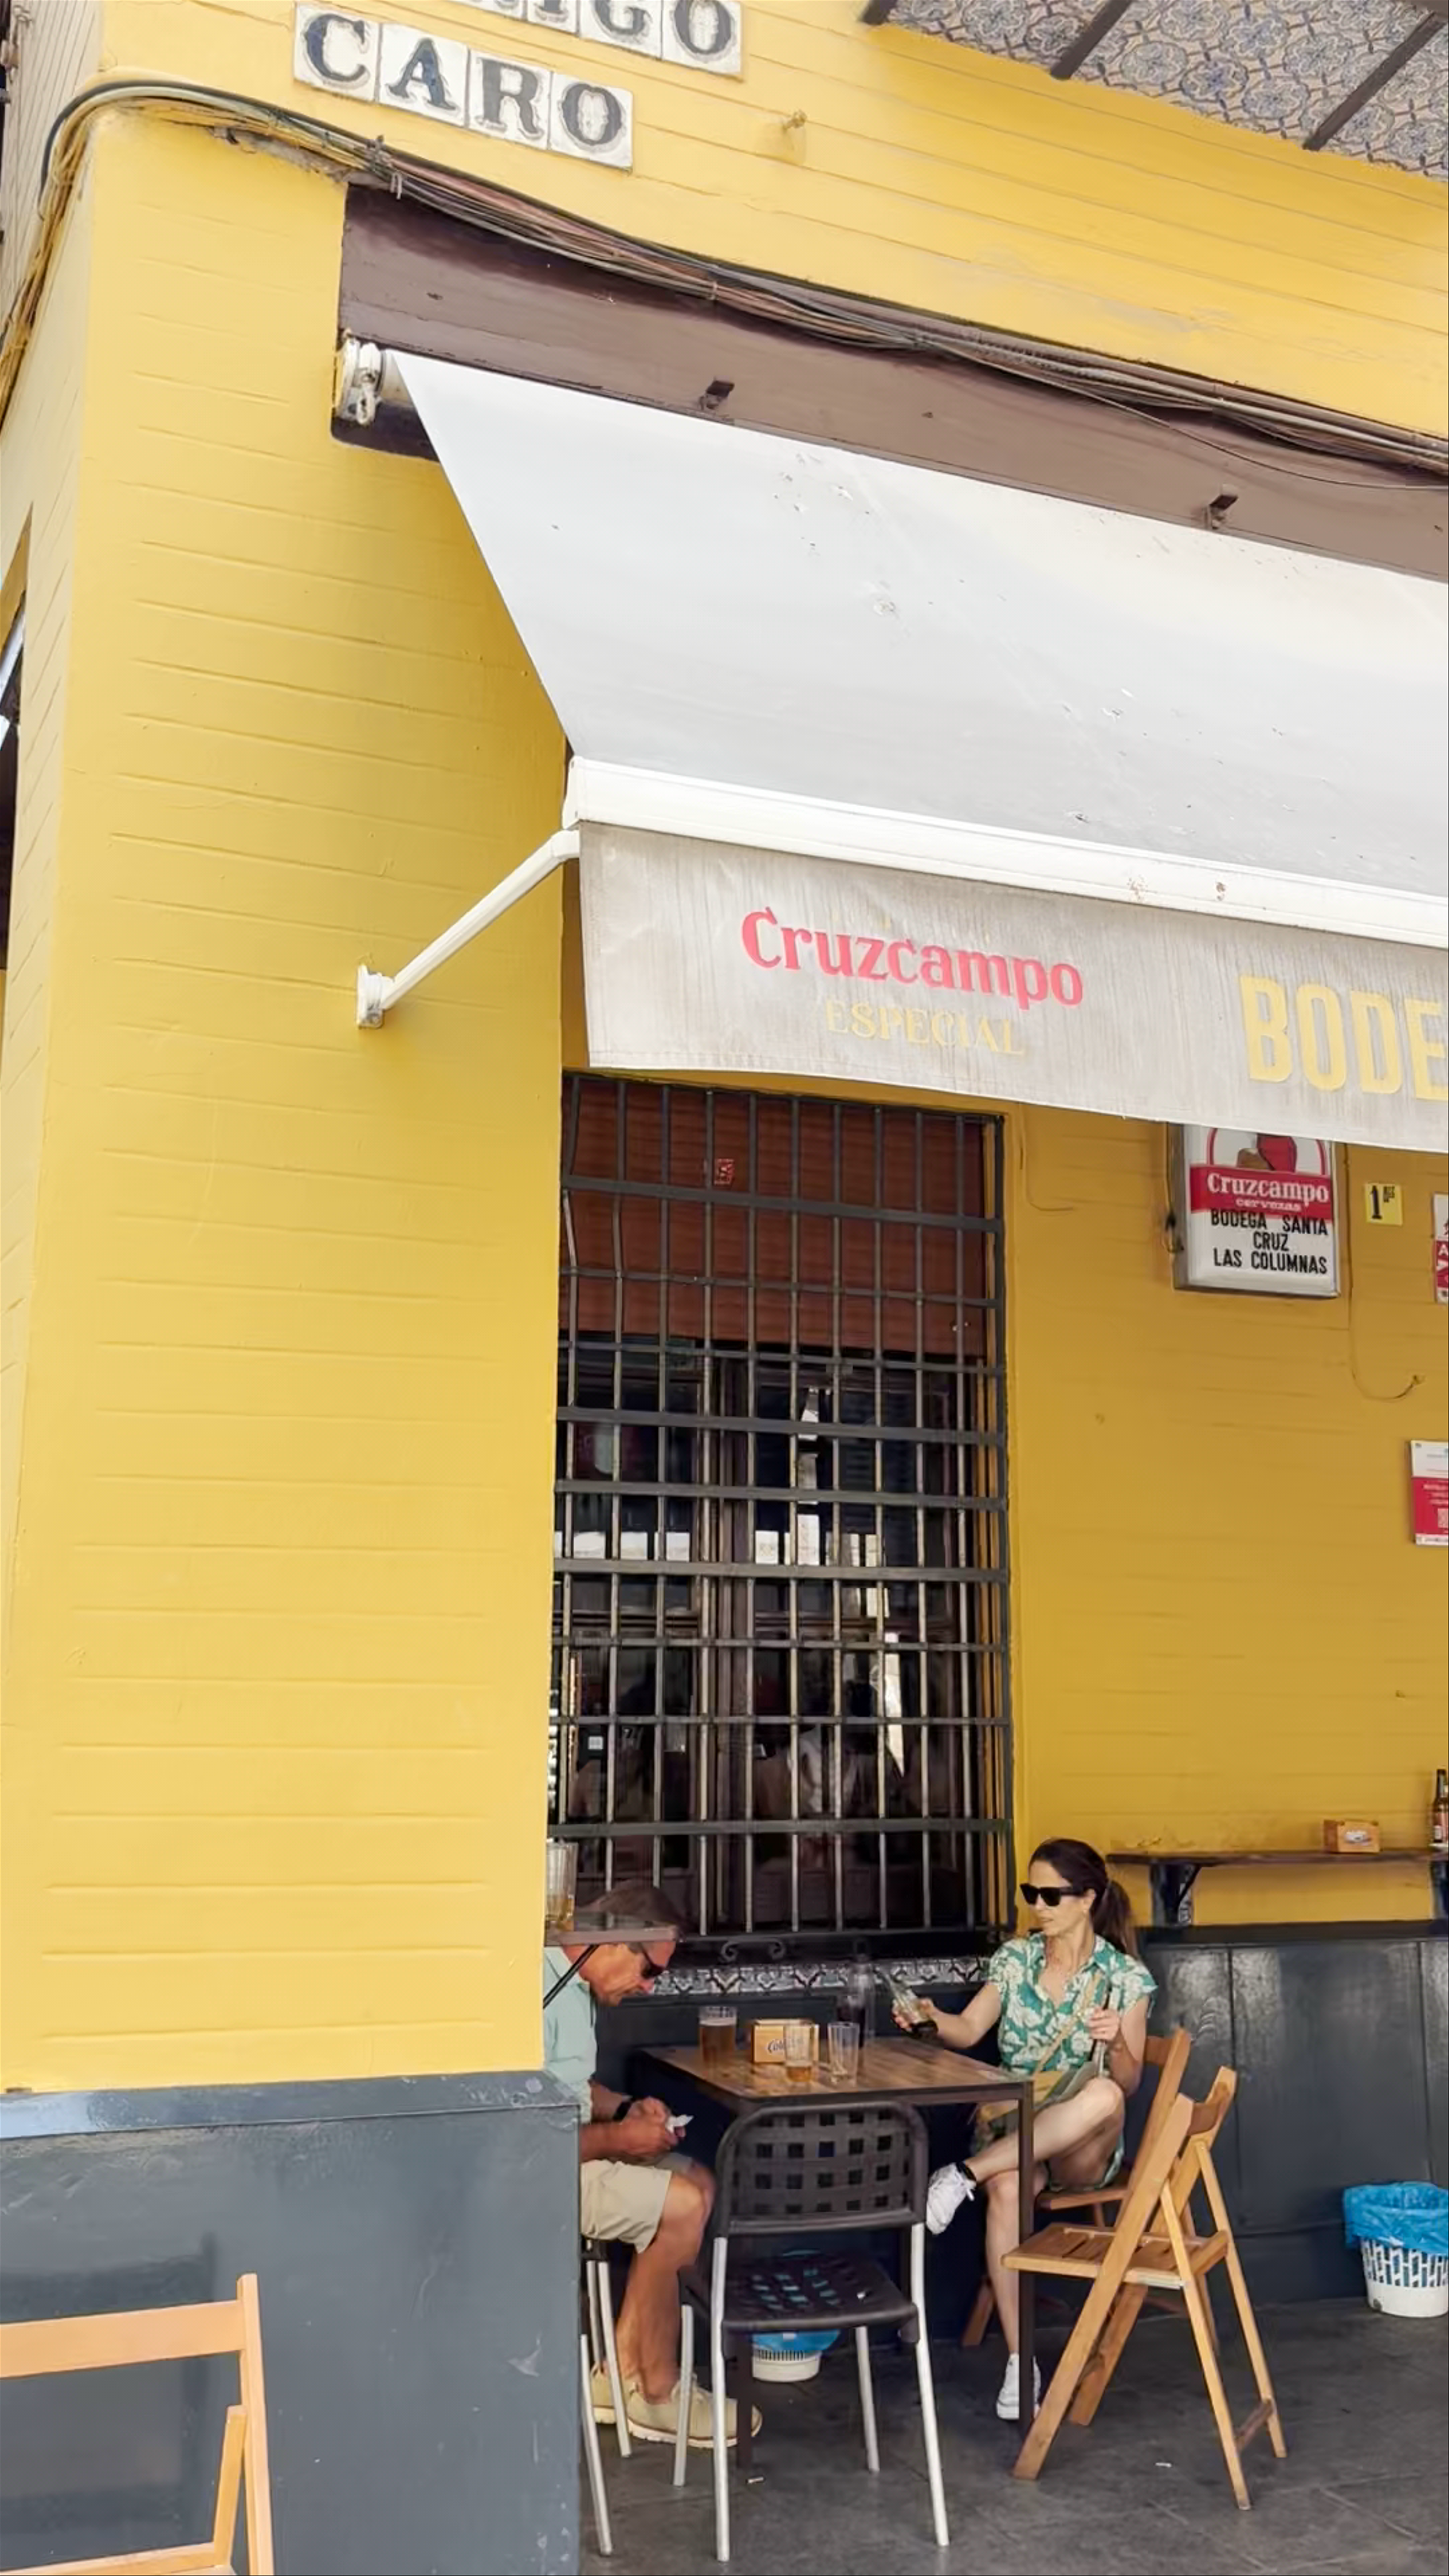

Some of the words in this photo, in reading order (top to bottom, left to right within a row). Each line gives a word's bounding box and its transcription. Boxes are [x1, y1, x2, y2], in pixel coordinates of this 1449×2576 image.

[303, 13, 623, 146] CARO
[742, 907, 1083, 1010] Cruzcampo
[826, 998, 1025, 1055] ESPECIAL
[1239, 975, 1448, 1100] BODE
[1208, 1173, 1329, 1206] Cruzcampo
[1211, 1210, 1267, 1229] BODEGA
[1283, 1215, 1328, 1235] SANTA
[1253, 1231, 1289, 1251] CRUZ
[1213, 1248, 1242, 1267] LAS
[1251, 1251, 1327, 1274] COLUMNAS
